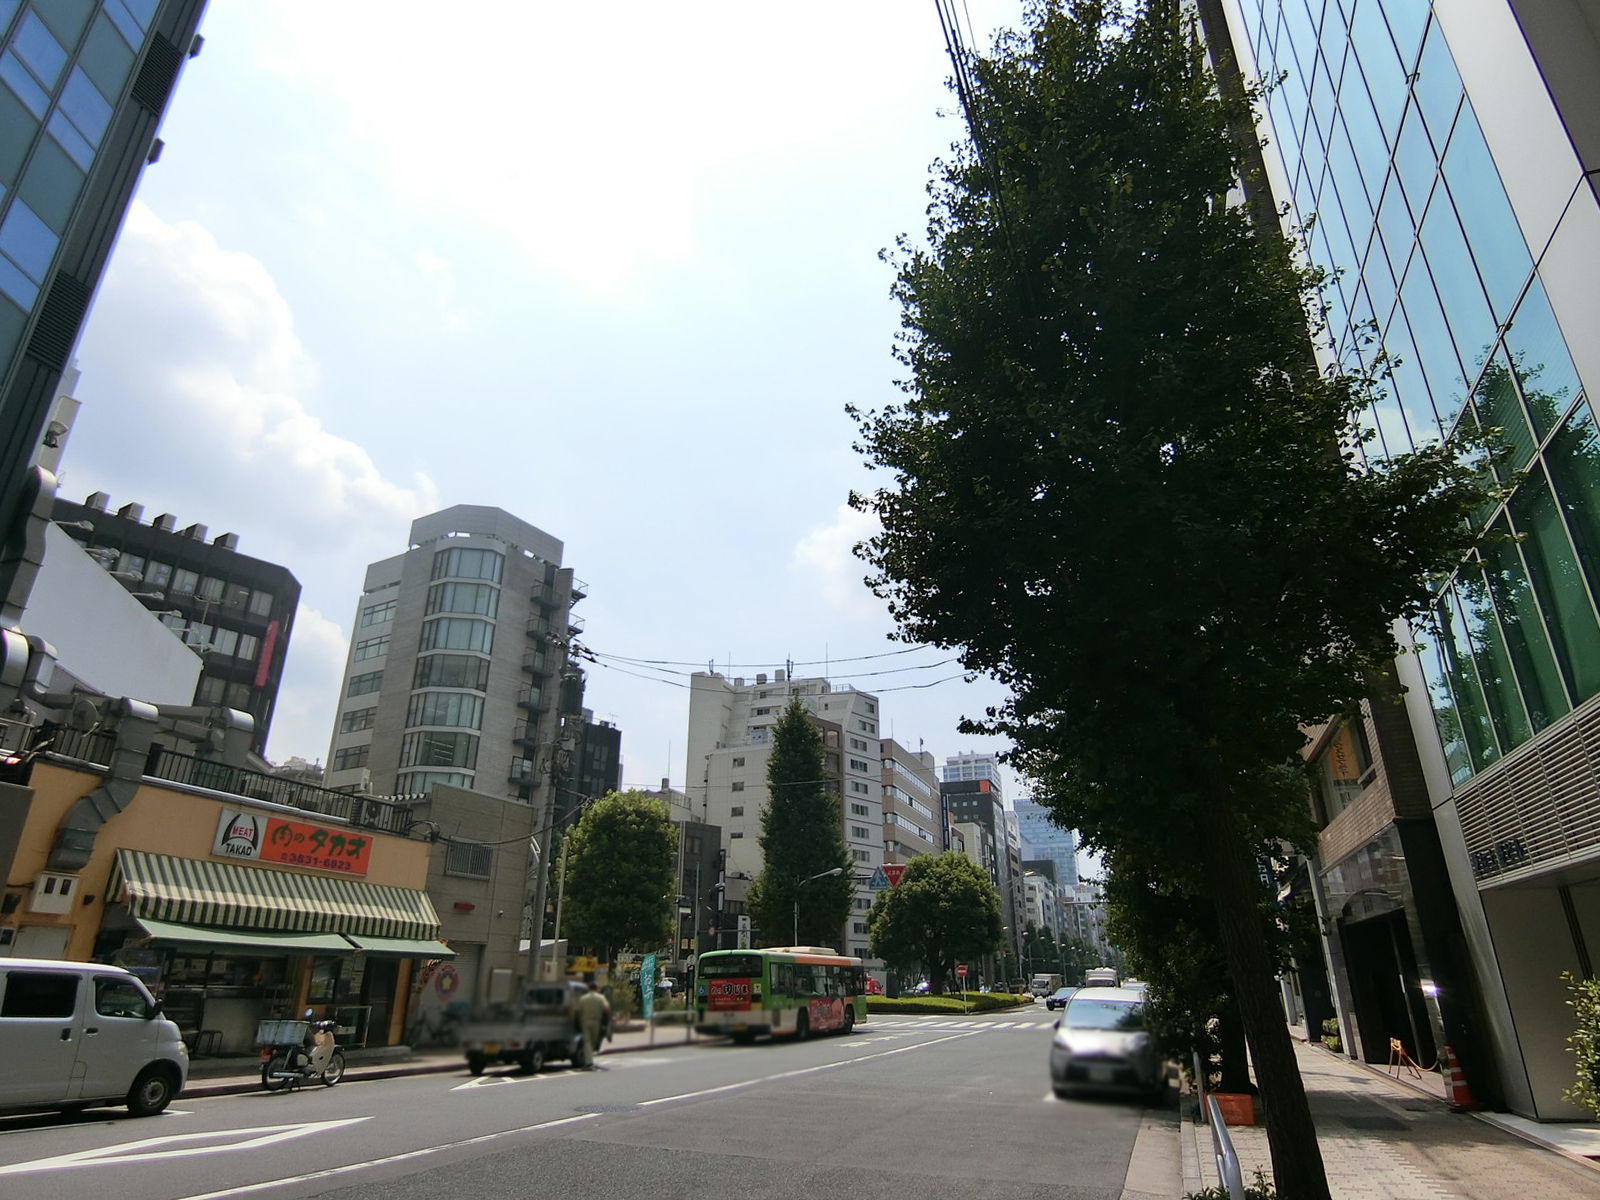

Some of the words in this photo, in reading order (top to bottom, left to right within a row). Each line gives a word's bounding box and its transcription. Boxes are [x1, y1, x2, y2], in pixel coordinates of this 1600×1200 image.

[232, 825, 253, 837] MEAT
[271, 823, 366, 859] 肉のタカオ
[225, 843, 252, 856] TAKAO
